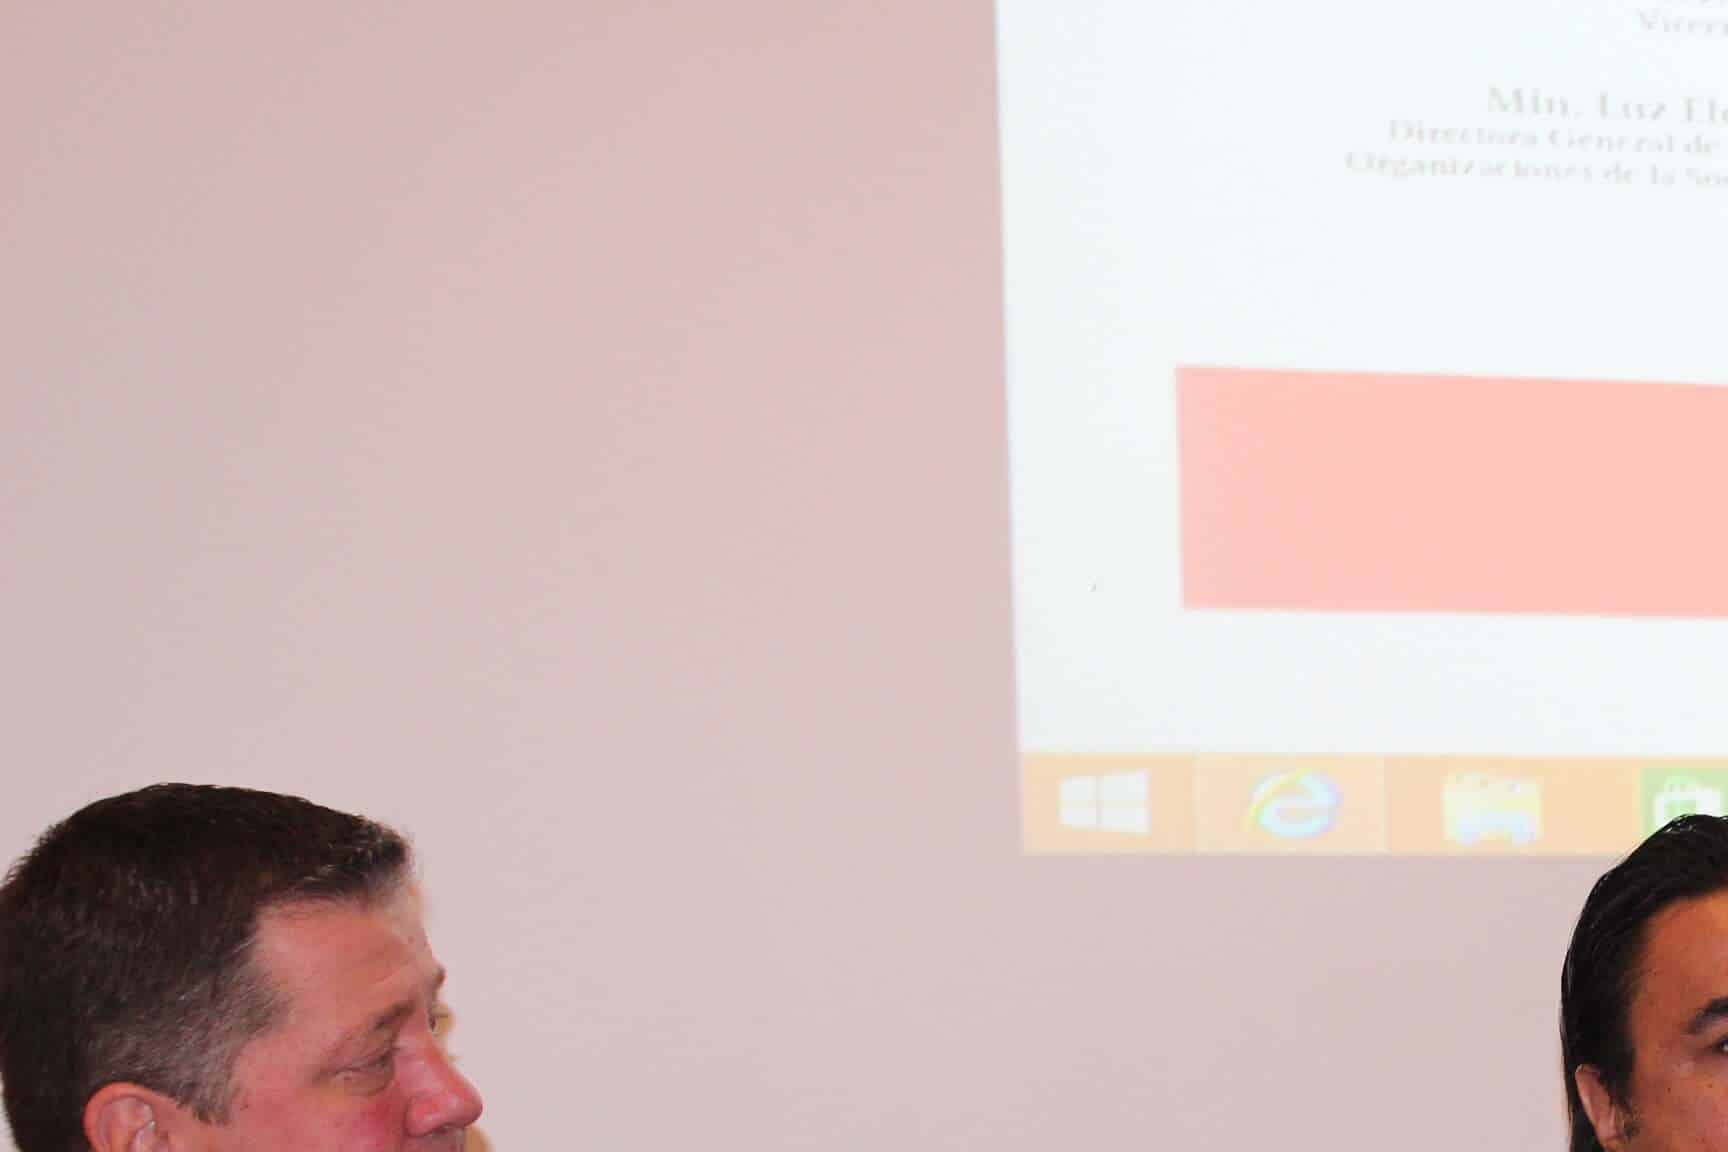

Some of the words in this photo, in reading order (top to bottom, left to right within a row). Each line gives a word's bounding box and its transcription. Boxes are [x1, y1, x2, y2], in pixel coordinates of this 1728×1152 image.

[1486, 86, 1582, 118] Min.
[1596, 92, 1665, 121] Luz
[1549, 127, 1675, 153] General
[1684, 135, 1712, 154] de
[1602, 160, 1632, 185] de
[1650, 163, 1677, 186] la
